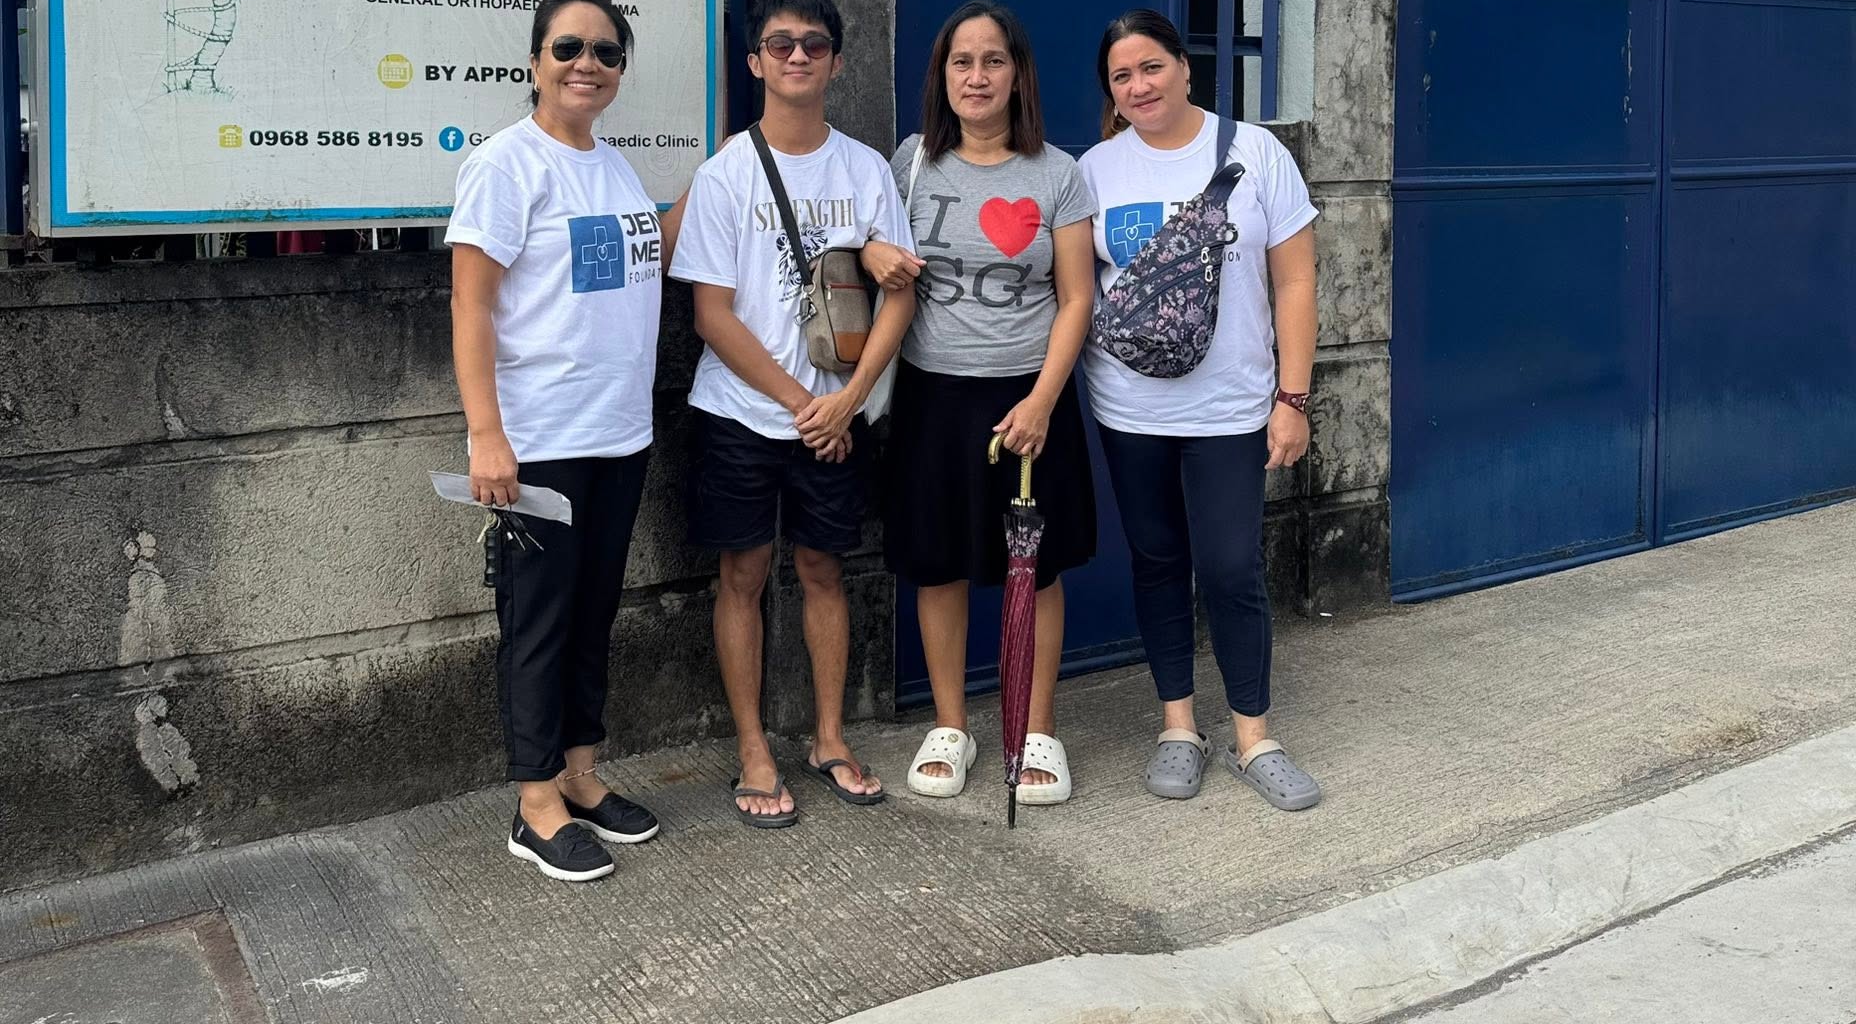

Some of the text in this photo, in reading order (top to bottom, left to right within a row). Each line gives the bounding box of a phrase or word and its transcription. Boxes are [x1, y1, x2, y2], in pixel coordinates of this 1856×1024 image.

[424, 65, 457, 82] BY
[249, 130, 424, 147] 0968 586 8195
[656, 134, 699, 148] Clinic
[754, 198, 853, 233] STENGTH
[918, 194, 962, 249] I
[918, 255, 1033, 308] SG
